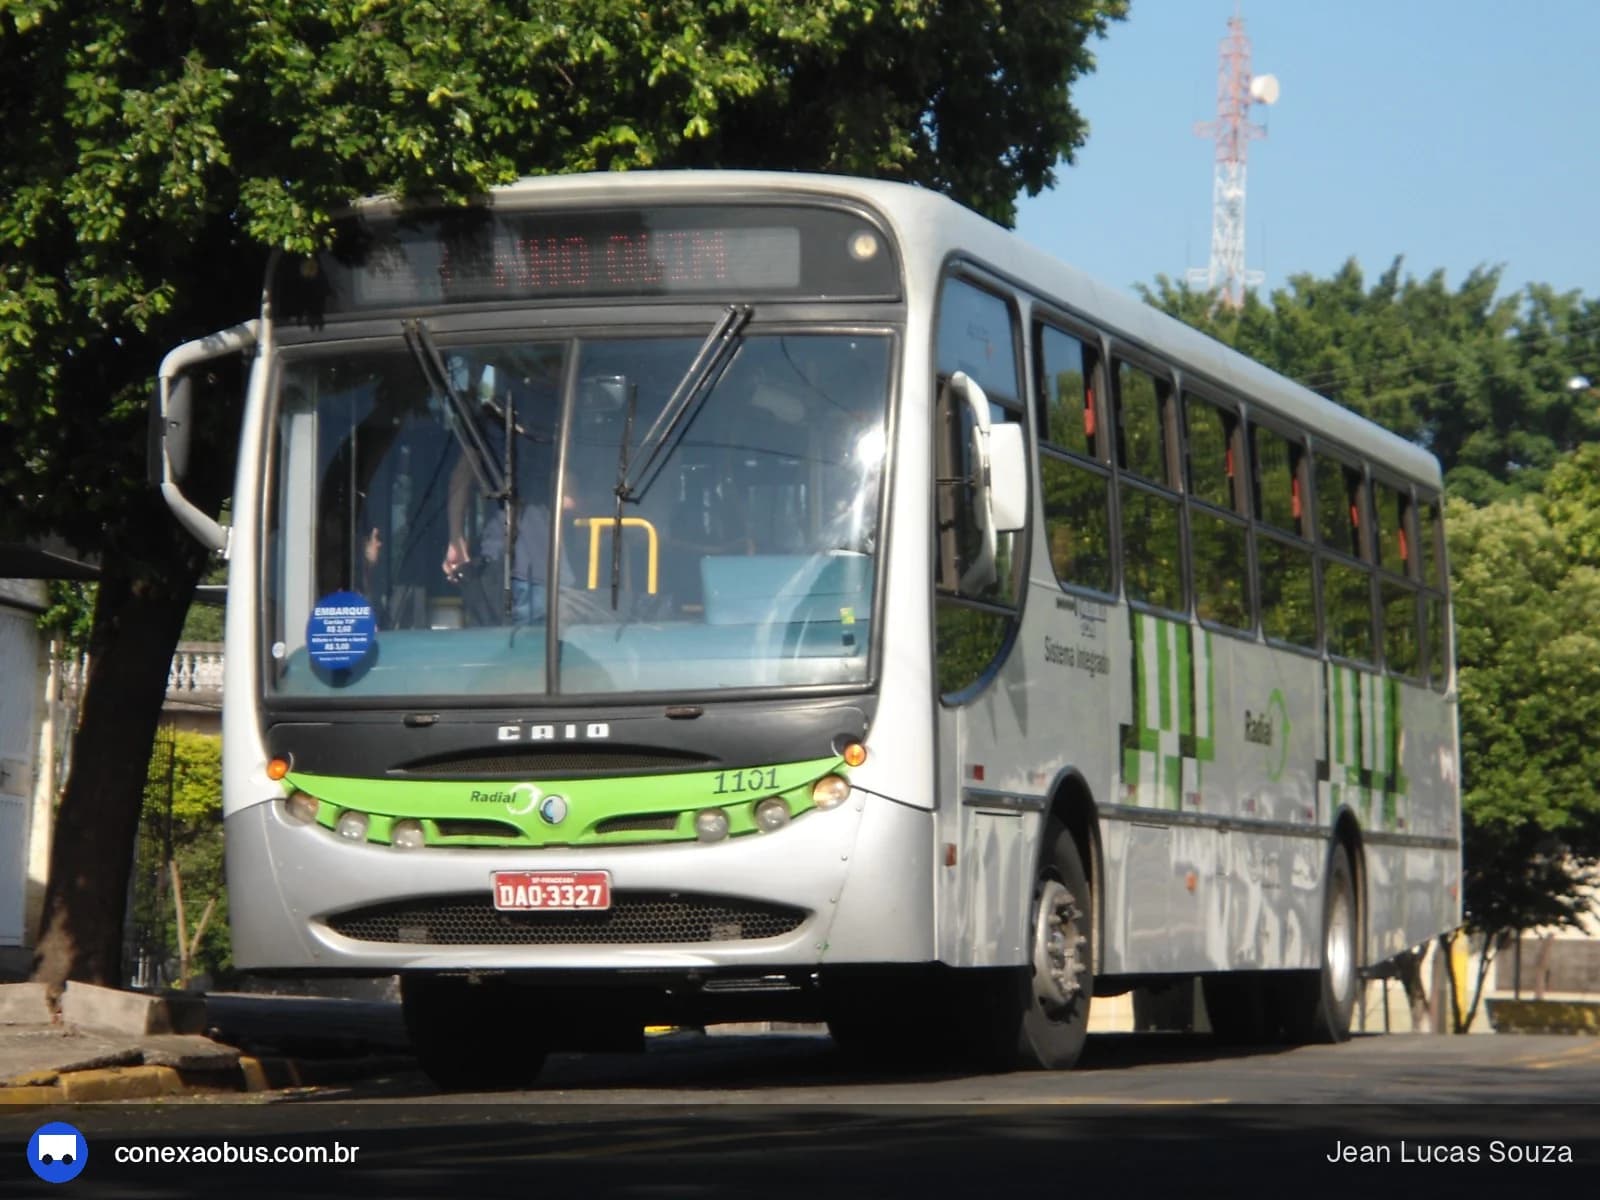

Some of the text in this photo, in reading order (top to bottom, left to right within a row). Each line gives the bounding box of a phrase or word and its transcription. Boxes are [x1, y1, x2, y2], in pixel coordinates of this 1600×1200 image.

[314, 606, 370, 616] EMBARQUE
[497, 723, 609, 741] CAIO
[713, 767, 780, 794] 1101
[470, 790, 517, 803] Radial
